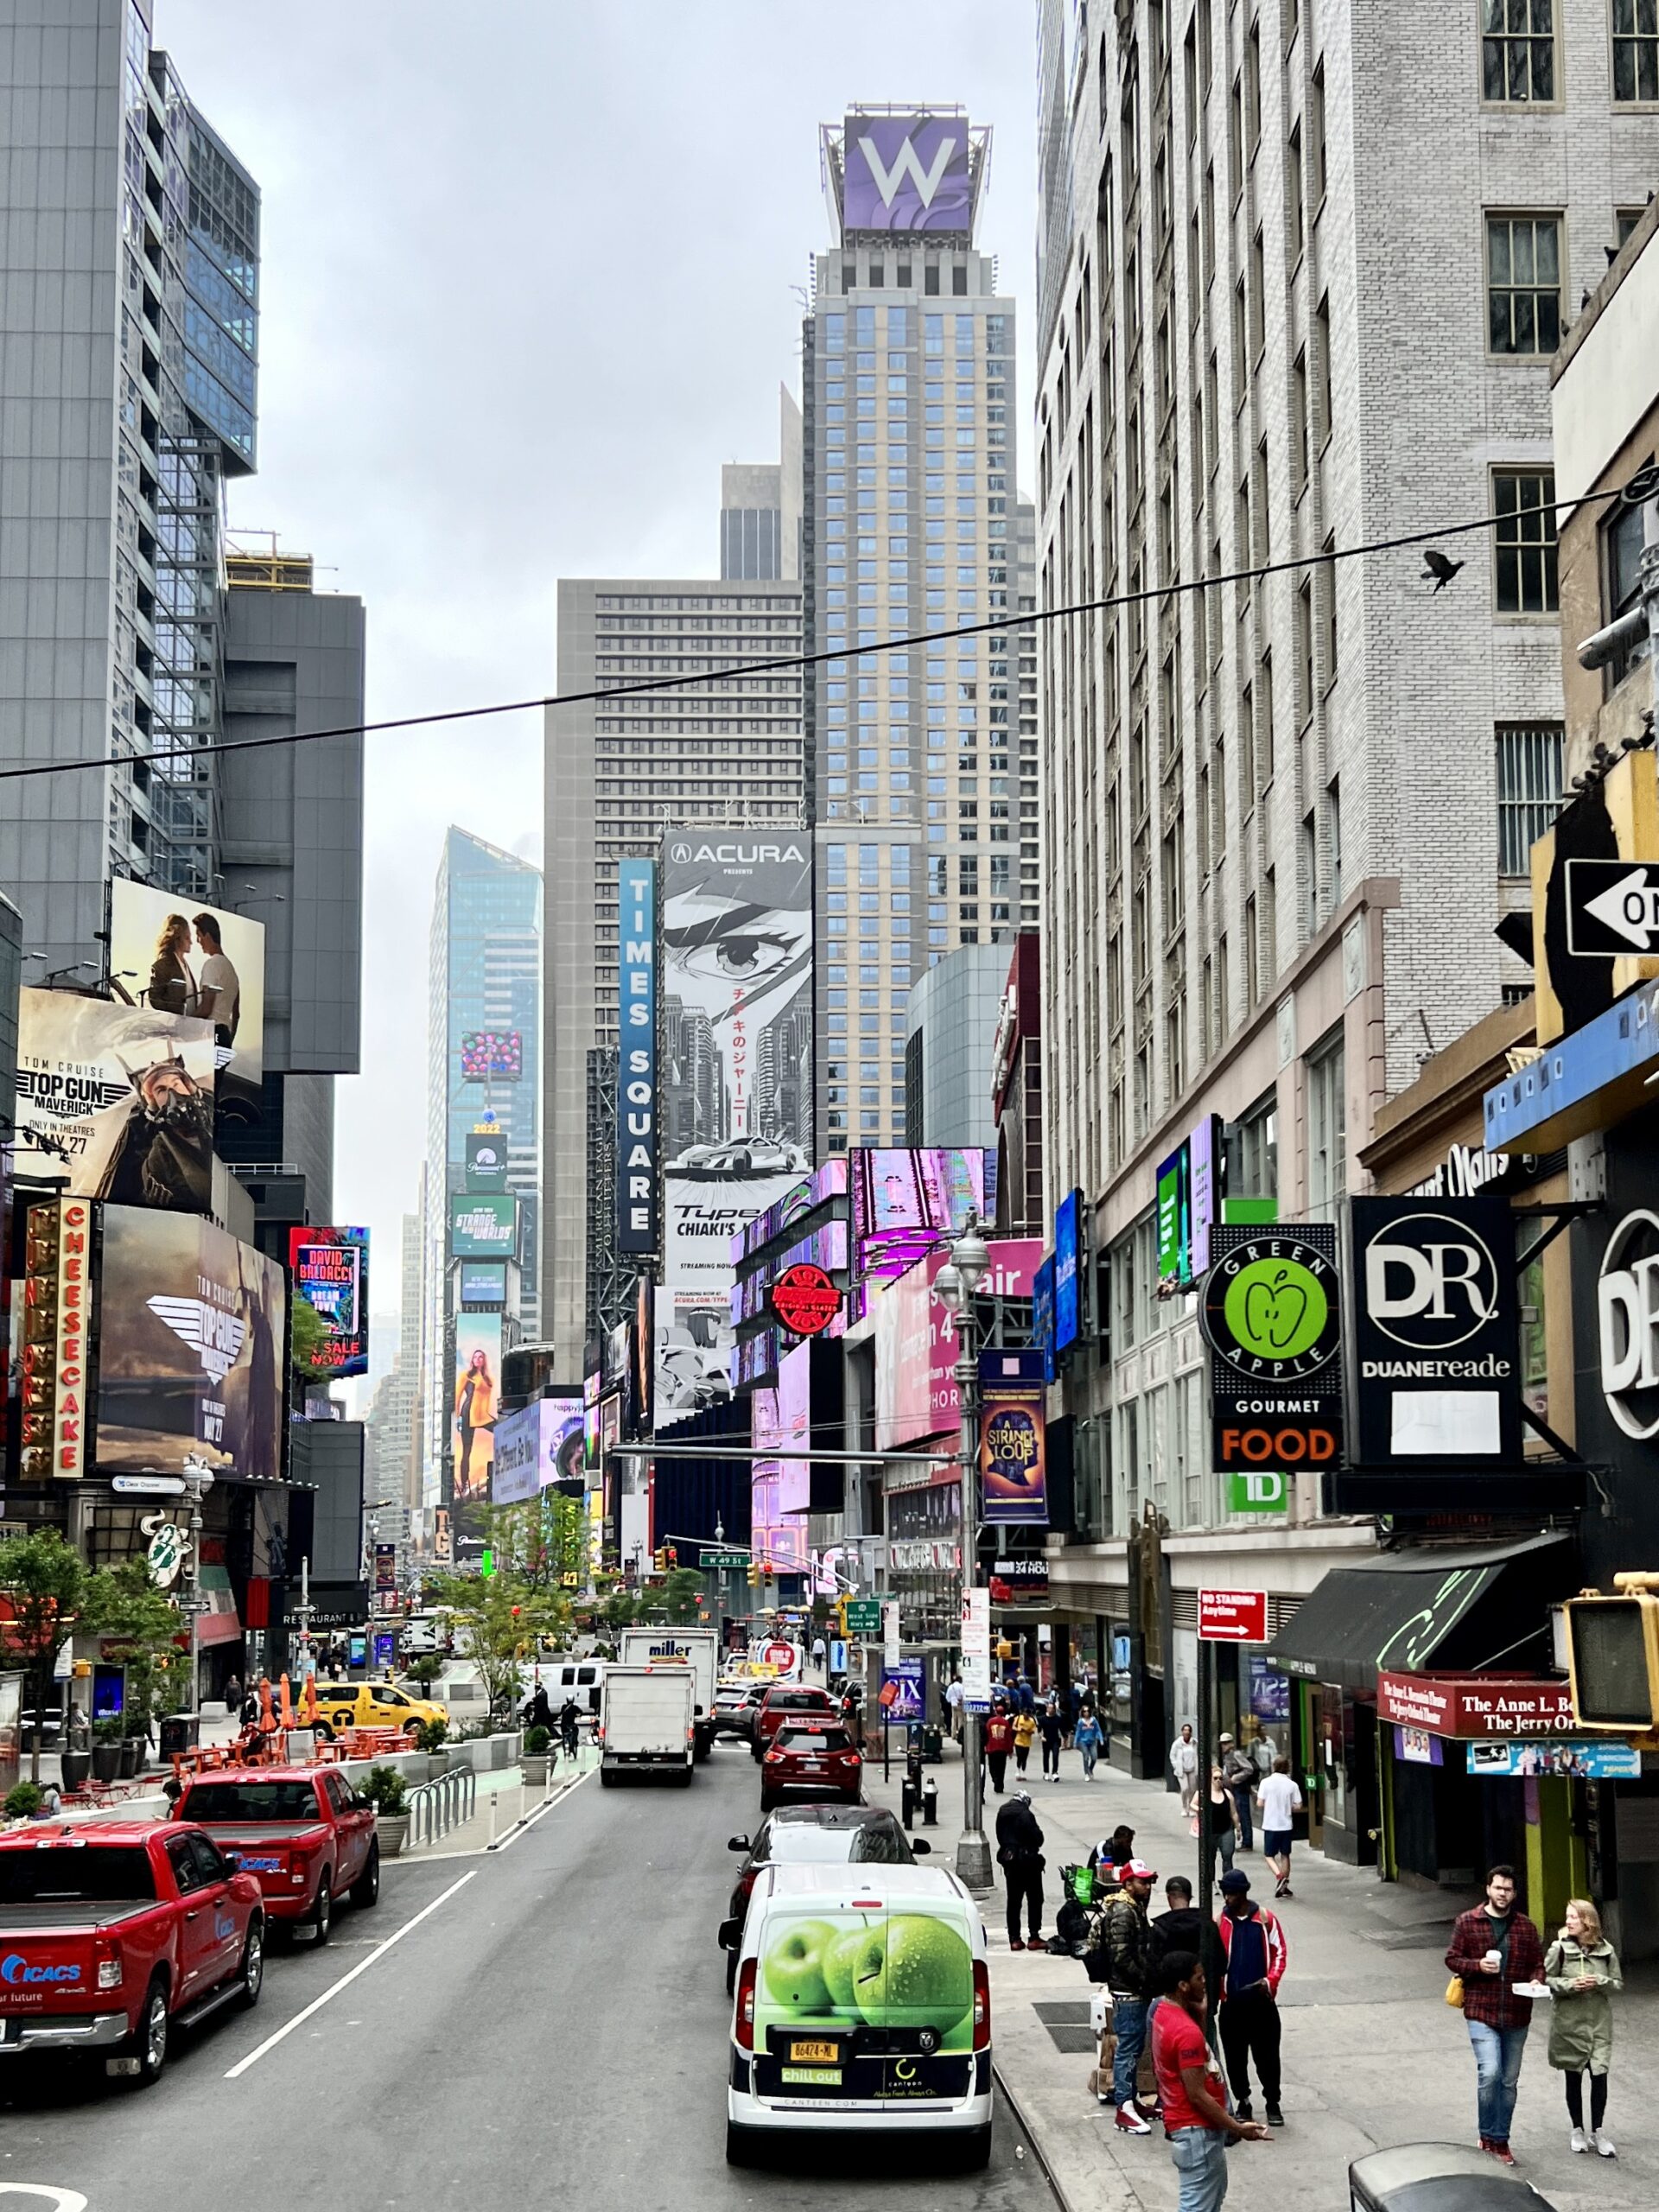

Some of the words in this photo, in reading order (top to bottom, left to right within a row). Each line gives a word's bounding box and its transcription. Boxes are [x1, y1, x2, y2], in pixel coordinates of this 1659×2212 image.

[857, 136, 957, 210] W
[694, 844, 804, 863] ACURA
[626, 880, 652, 1027] TIMES
[24, 1056, 49, 1070] TOM
[58, 1061, 104, 1079] CRUISE
[27, 1071, 63, 1097] TOP
[66, 1077, 103, 1104] GUN
[35, 1095, 93, 1116] MAVERICK
[29, 1119, 48, 1131] ONLY
[50, 1122, 57, 1131] IN
[60, 1123, 96, 1137] THEATRES
[474, 1124, 501, 1134] 2022
[69, 1136, 87, 1154] 27
[626, 1050, 652, 1230] SQUARE
[456, 1214, 498, 1227] STRANGE
[674, 1205, 760, 1221] Type
[677, 1223, 735, 1236] CHIAKI'S
[309, 1250, 342, 1266] DAVID
[1225, 1241, 1325, 1275] GREEN
[300, 1264, 353, 1283] BALDACCI
[1365, 1243, 1499, 1319] DR
[60, 1206, 85, 1469] CHEESECAKE
[323, 1342, 359, 1355] SALE
[311, 1354, 346, 1366] NOW
[1227, 1348, 1324, 1376] APPLE
[1363, 1354, 1510, 1378] DUANEreade
[1236, 1400, 1320, 1413] GOURMET
[1003, 1420, 1010, 1429] A
[988, 1428, 1035, 1448] STRANGE
[1222, 1428, 1335, 1460] FOOD
[995, 1440, 1033, 1465] LOOP
[1237, 1471, 1281, 1502] TD
[1015, 1566, 1027, 1574] 24
[1202, 1593, 1214, 1604] NO
[1216, 1594, 1256, 1606] STANDING
[283, 1612, 346, 1624] RESAURANT
[1202, 1605, 1237, 1617] Anytime
[649, 1640, 691, 1656] miller
[1462, 1696, 1492, 1712] The
[1495, 1696, 1535, 1712] Anne
[1539, 1697, 1555, 1712] L.
[1484, 1714, 1512, 1730] The
[1513, 1714, 1552, 1735] Jerry
[10, 1993, 43, 2002] future
[782, 2069, 814, 2082] chill
[816, 2070, 840, 2082] out
